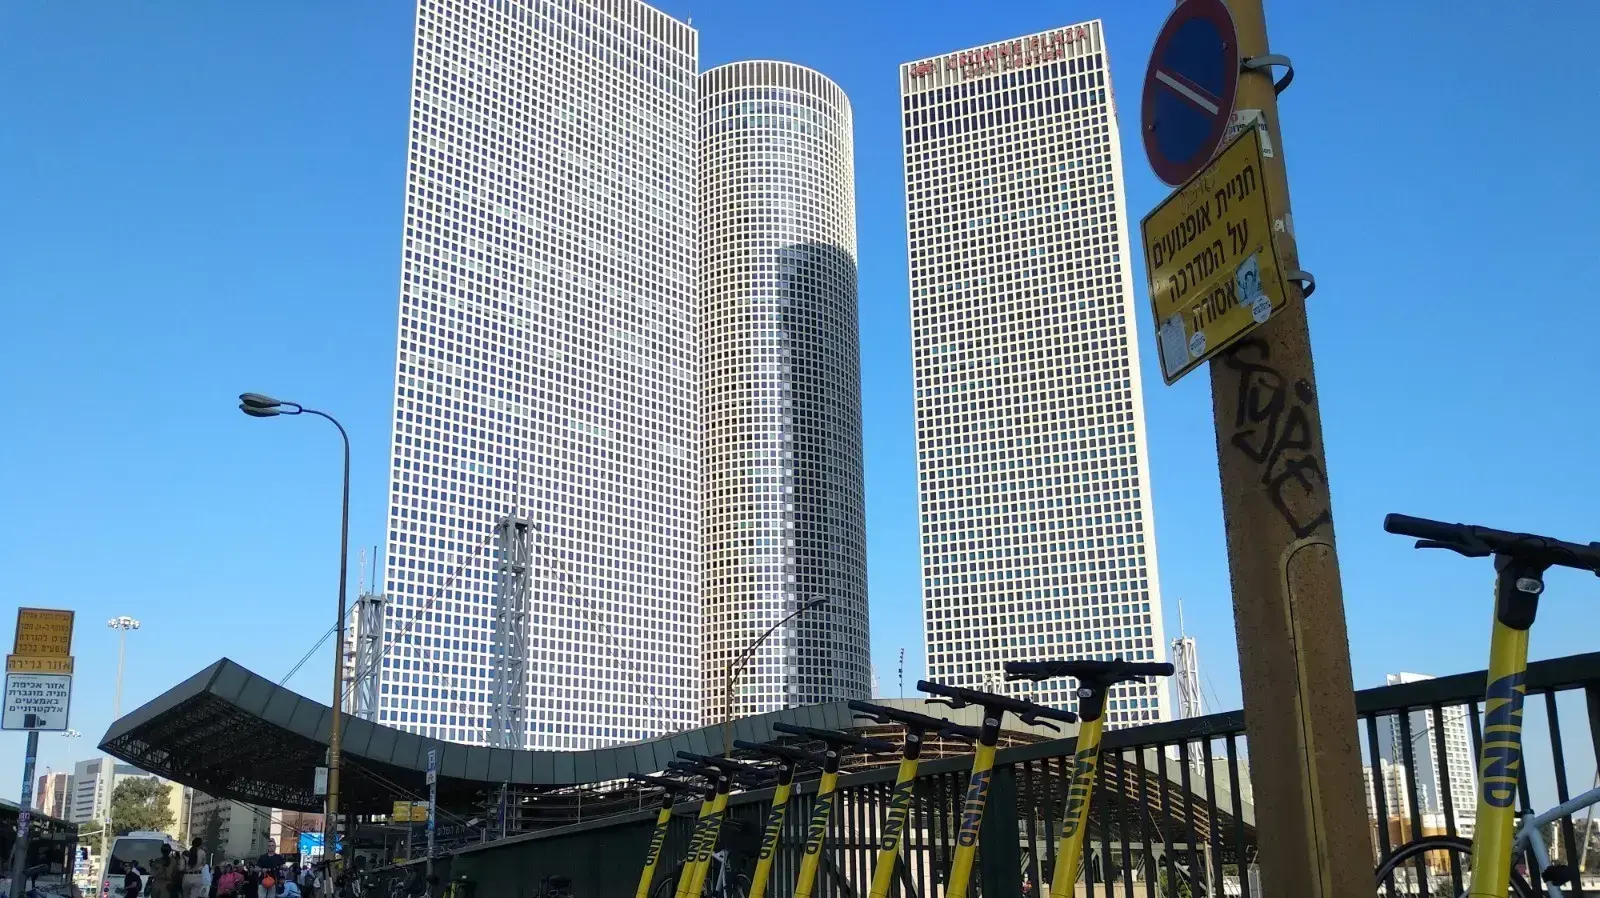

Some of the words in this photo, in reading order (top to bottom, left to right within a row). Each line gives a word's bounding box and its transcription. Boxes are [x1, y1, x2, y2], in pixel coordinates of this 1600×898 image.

[1031, 27, 1087, 51] PLAZA
[1214, 163, 1256, 220] חניית
[1152, 200, 1213, 270] אופנועים
[1226, 217, 1249, 256] על
[1168, 238, 1226, 303] המדרכה
[1191, 276, 1240, 332] אסורה
[9, 659, 42, 669] גרירה
[12, 681, 42, 689] אכיפת
[45, 682, 65, 690] אזור
[47, 660, 71, 670] אזור
[8, 689, 43, 697] מוגברת
[9, 705, 63, 714] אלקטרוניים
[15, 697, 59, 705] באמצעים
[1484, 671, 1526, 808] WIND
[881, 779, 914, 851] WIND
[958, 769, 993, 847] WIND
[1061, 745, 1098, 839] WIND
[645, 821, 668, 866] WIND
[698, 810, 723, 863] WIND
[759, 804, 787, 860] WIND
[806, 792, 835, 855] WIND
